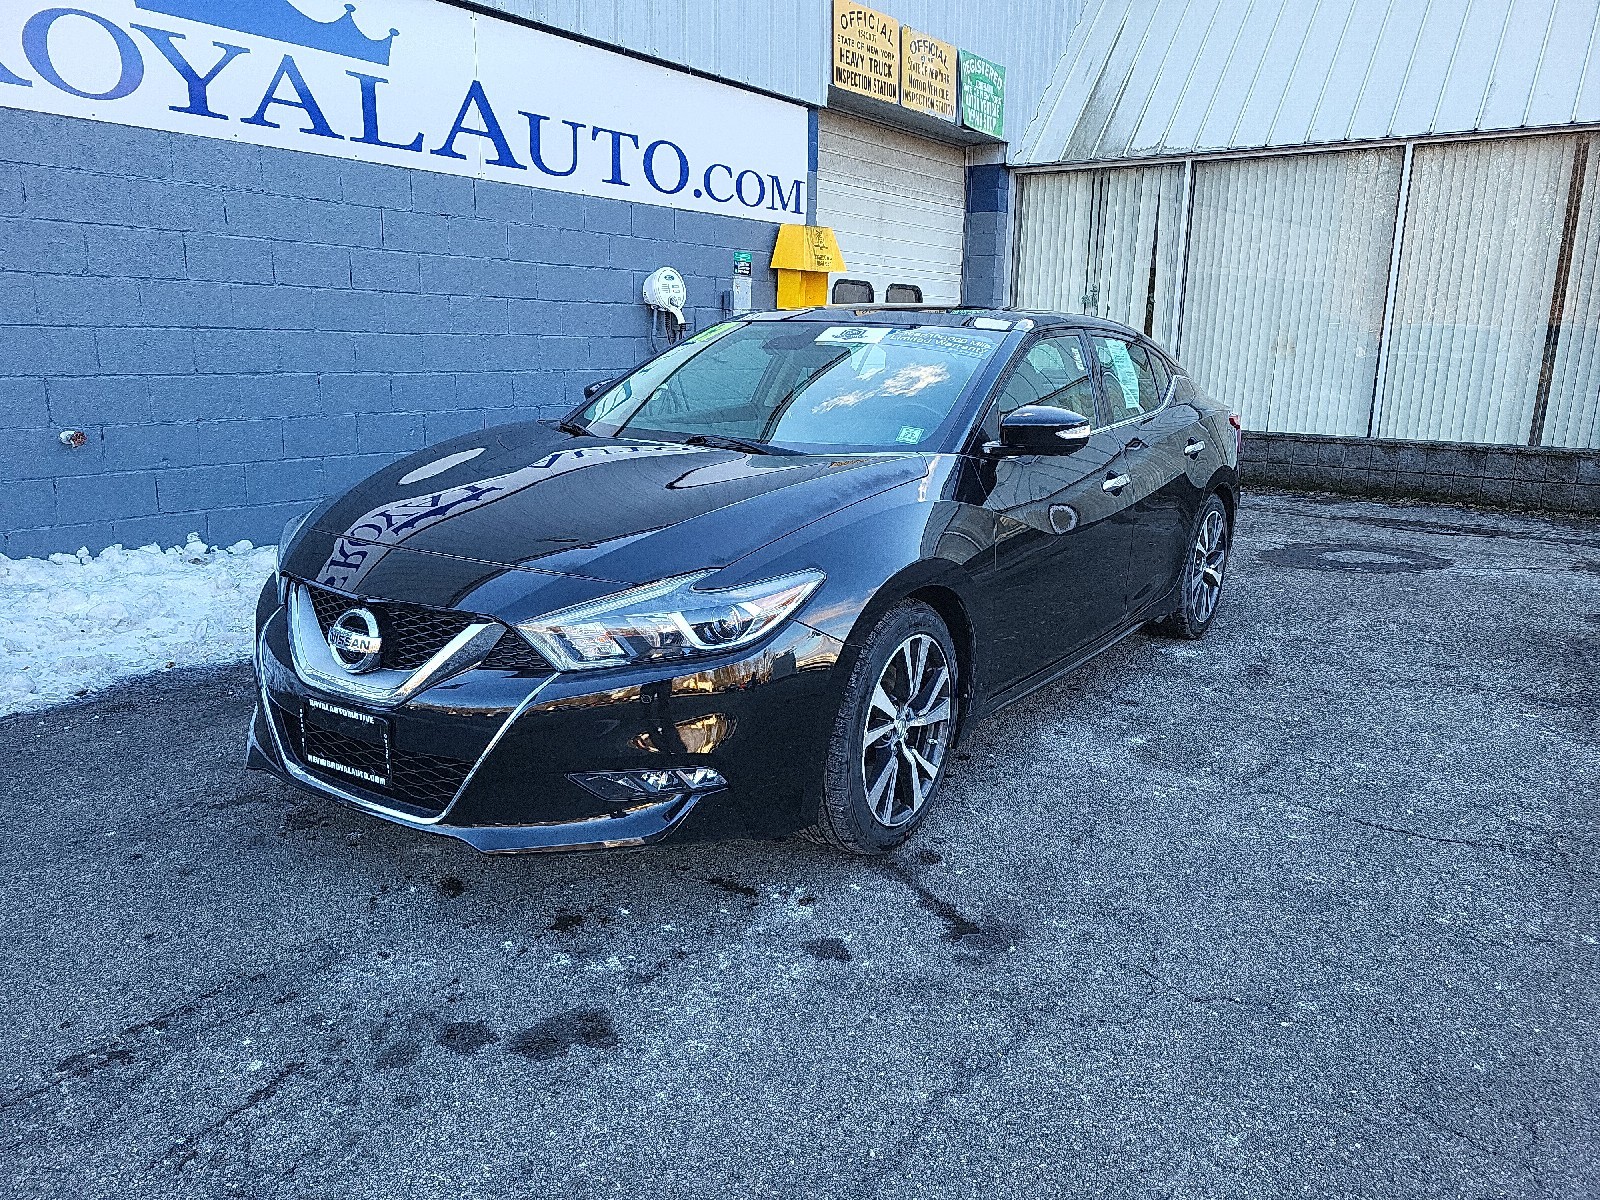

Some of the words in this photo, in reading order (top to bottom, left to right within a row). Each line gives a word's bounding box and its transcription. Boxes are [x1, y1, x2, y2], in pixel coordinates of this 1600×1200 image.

[837, 33, 855, 48] STATE
[856, 41, 864, 51] OF
[866, 44, 879, 56] NEW
[840, 10, 894, 47] OFFICIAL
[839, 46, 865, 71] HEAVY
[869, 56, 893, 79] TRUCK
[909, 39, 949, 71] OFFICIAL
[835, 65, 872, 92] INSPECTION
[873, 77, 897, 99] STATION
[908, 73, 927, 94] MOTOR
[927, 80, 950, 101] VEHICLE
[962, 58, 1003, 91] REGISTERED
[889, 334, 933, 345] Limited
[935, 340, 989, 354] Warranty
[330, 630, 370, 650] NISSAN
